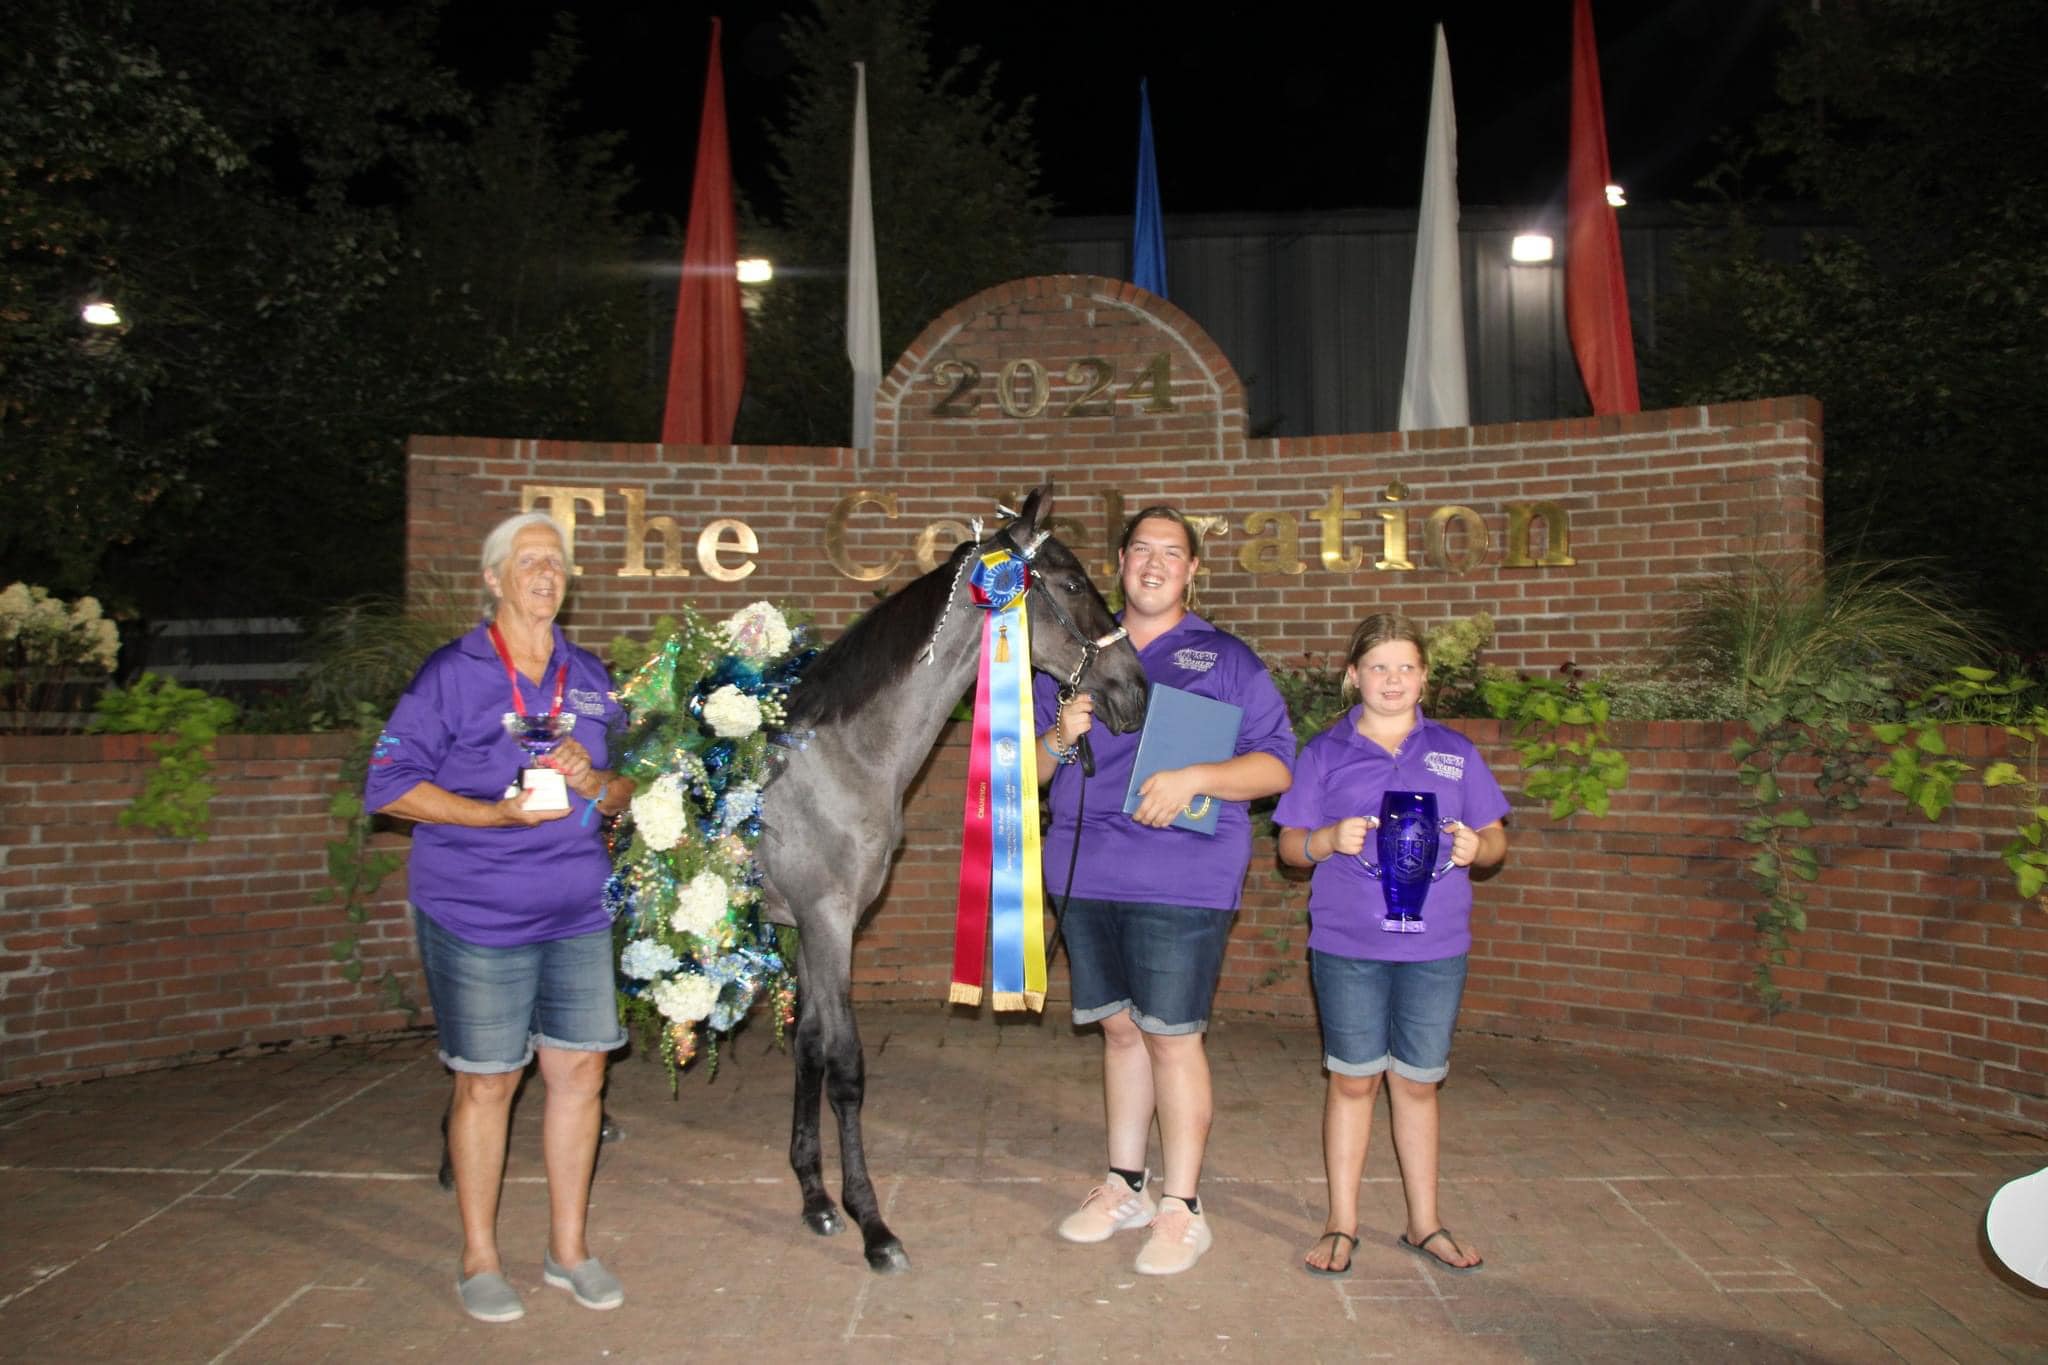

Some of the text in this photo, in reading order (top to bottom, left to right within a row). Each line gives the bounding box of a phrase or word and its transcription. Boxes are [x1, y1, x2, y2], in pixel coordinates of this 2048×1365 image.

[932, 352, 1179, 417] 2024
[521, 481, 1577, 581] The Ceration
